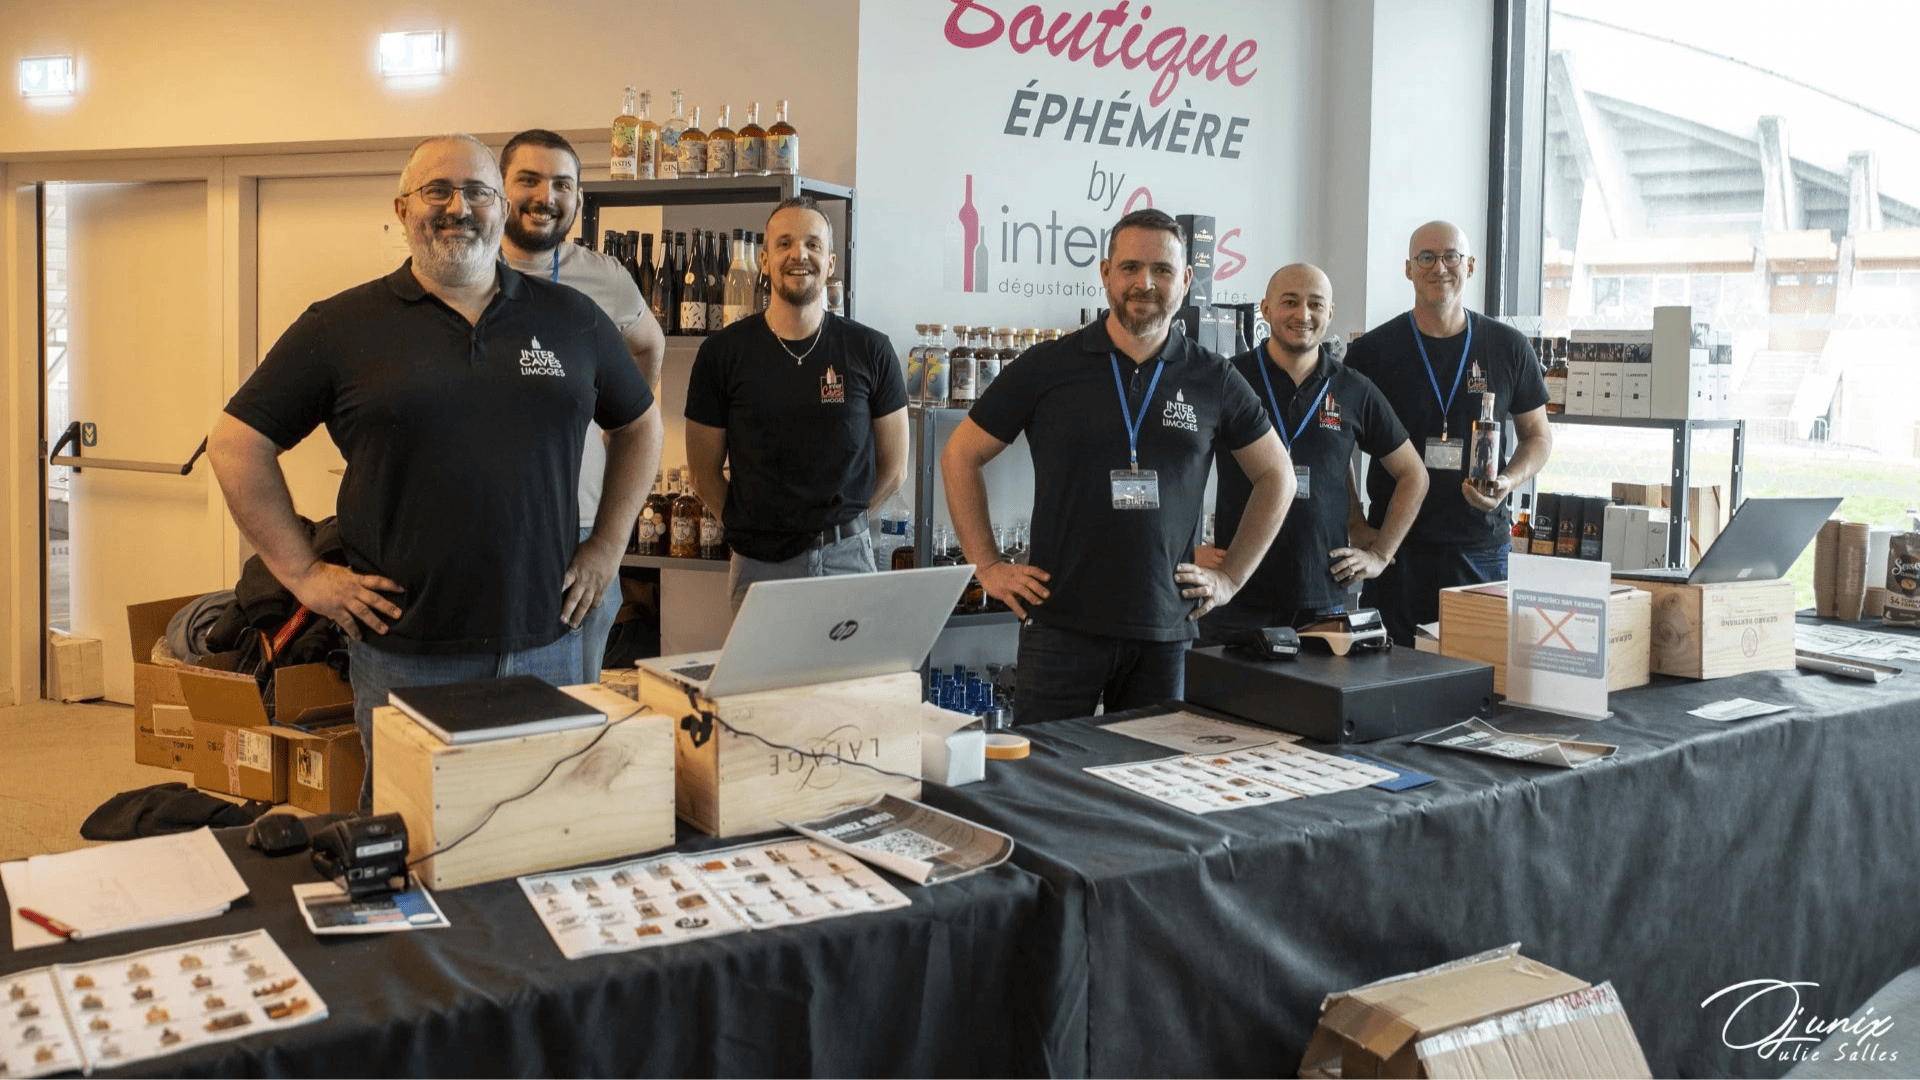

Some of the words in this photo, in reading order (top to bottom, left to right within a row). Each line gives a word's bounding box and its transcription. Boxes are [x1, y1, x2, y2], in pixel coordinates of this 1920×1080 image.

[1003, 79, 1251, 160] ÉPHÉMÈRE
[1087, 160, 1126, 211] by
[521, 349, 556, 360] INTER
[519, 357, 562, 369] CAVES
[520, 367, 566, 377] LIMOGES
[1166, 400, 1194, 414] INTER
[1163, 408, 1197, 423] CAVES
[1162, 418, 1198, 432] LIMOGES
